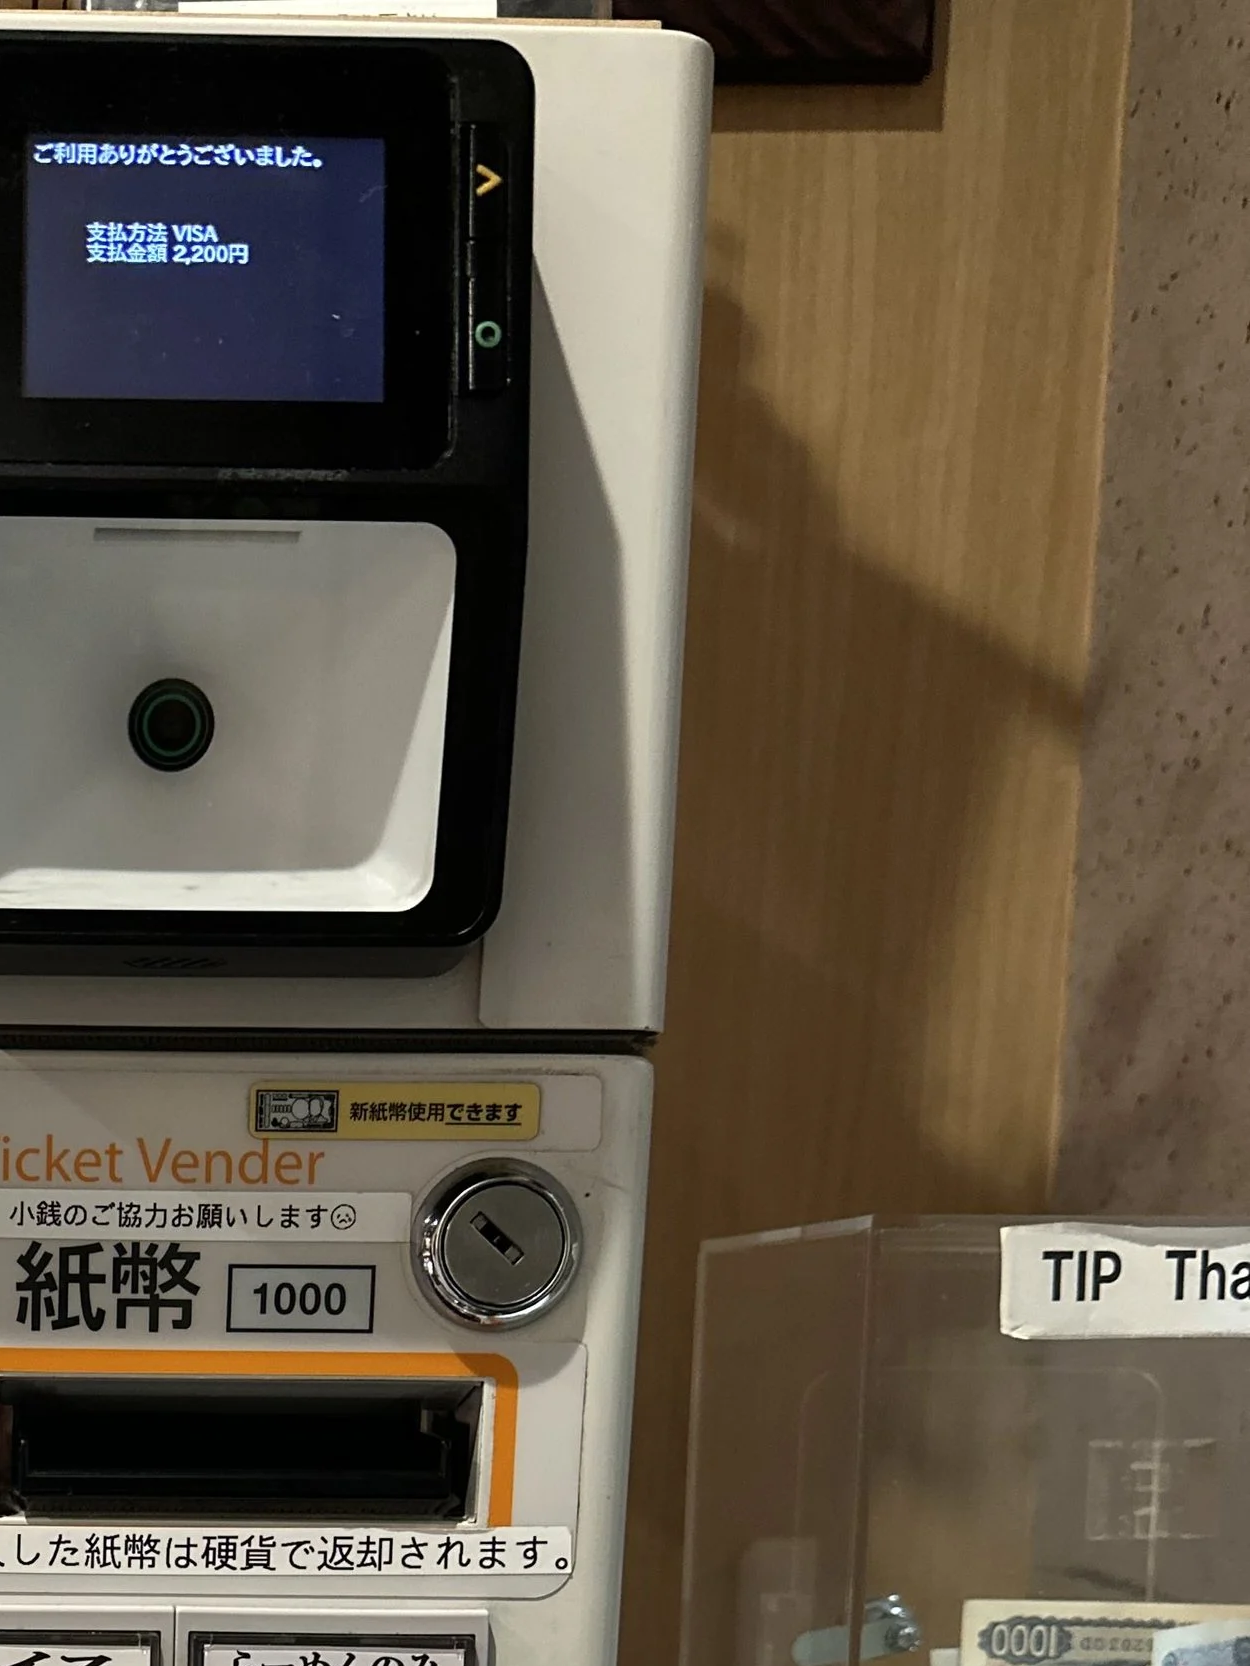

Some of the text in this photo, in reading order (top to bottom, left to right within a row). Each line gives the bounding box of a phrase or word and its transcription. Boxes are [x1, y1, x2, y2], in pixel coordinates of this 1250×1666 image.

[33, 142, 323, 168] ご利用ありがとうございました。
[87, 223, 218, 243] 支払方法 VISA
[87, 243, 249, 266] 支払金額 2,200円
[349, 1100, 522, 1125] 新紙幣使用できます
[138, 1137, 326, 1186] Vender
[15, 1241, 201, 1333] 紙幣
[1043, 1250, 1122, 1302] TIP
[253, 1284, 346, 1316] 1000
